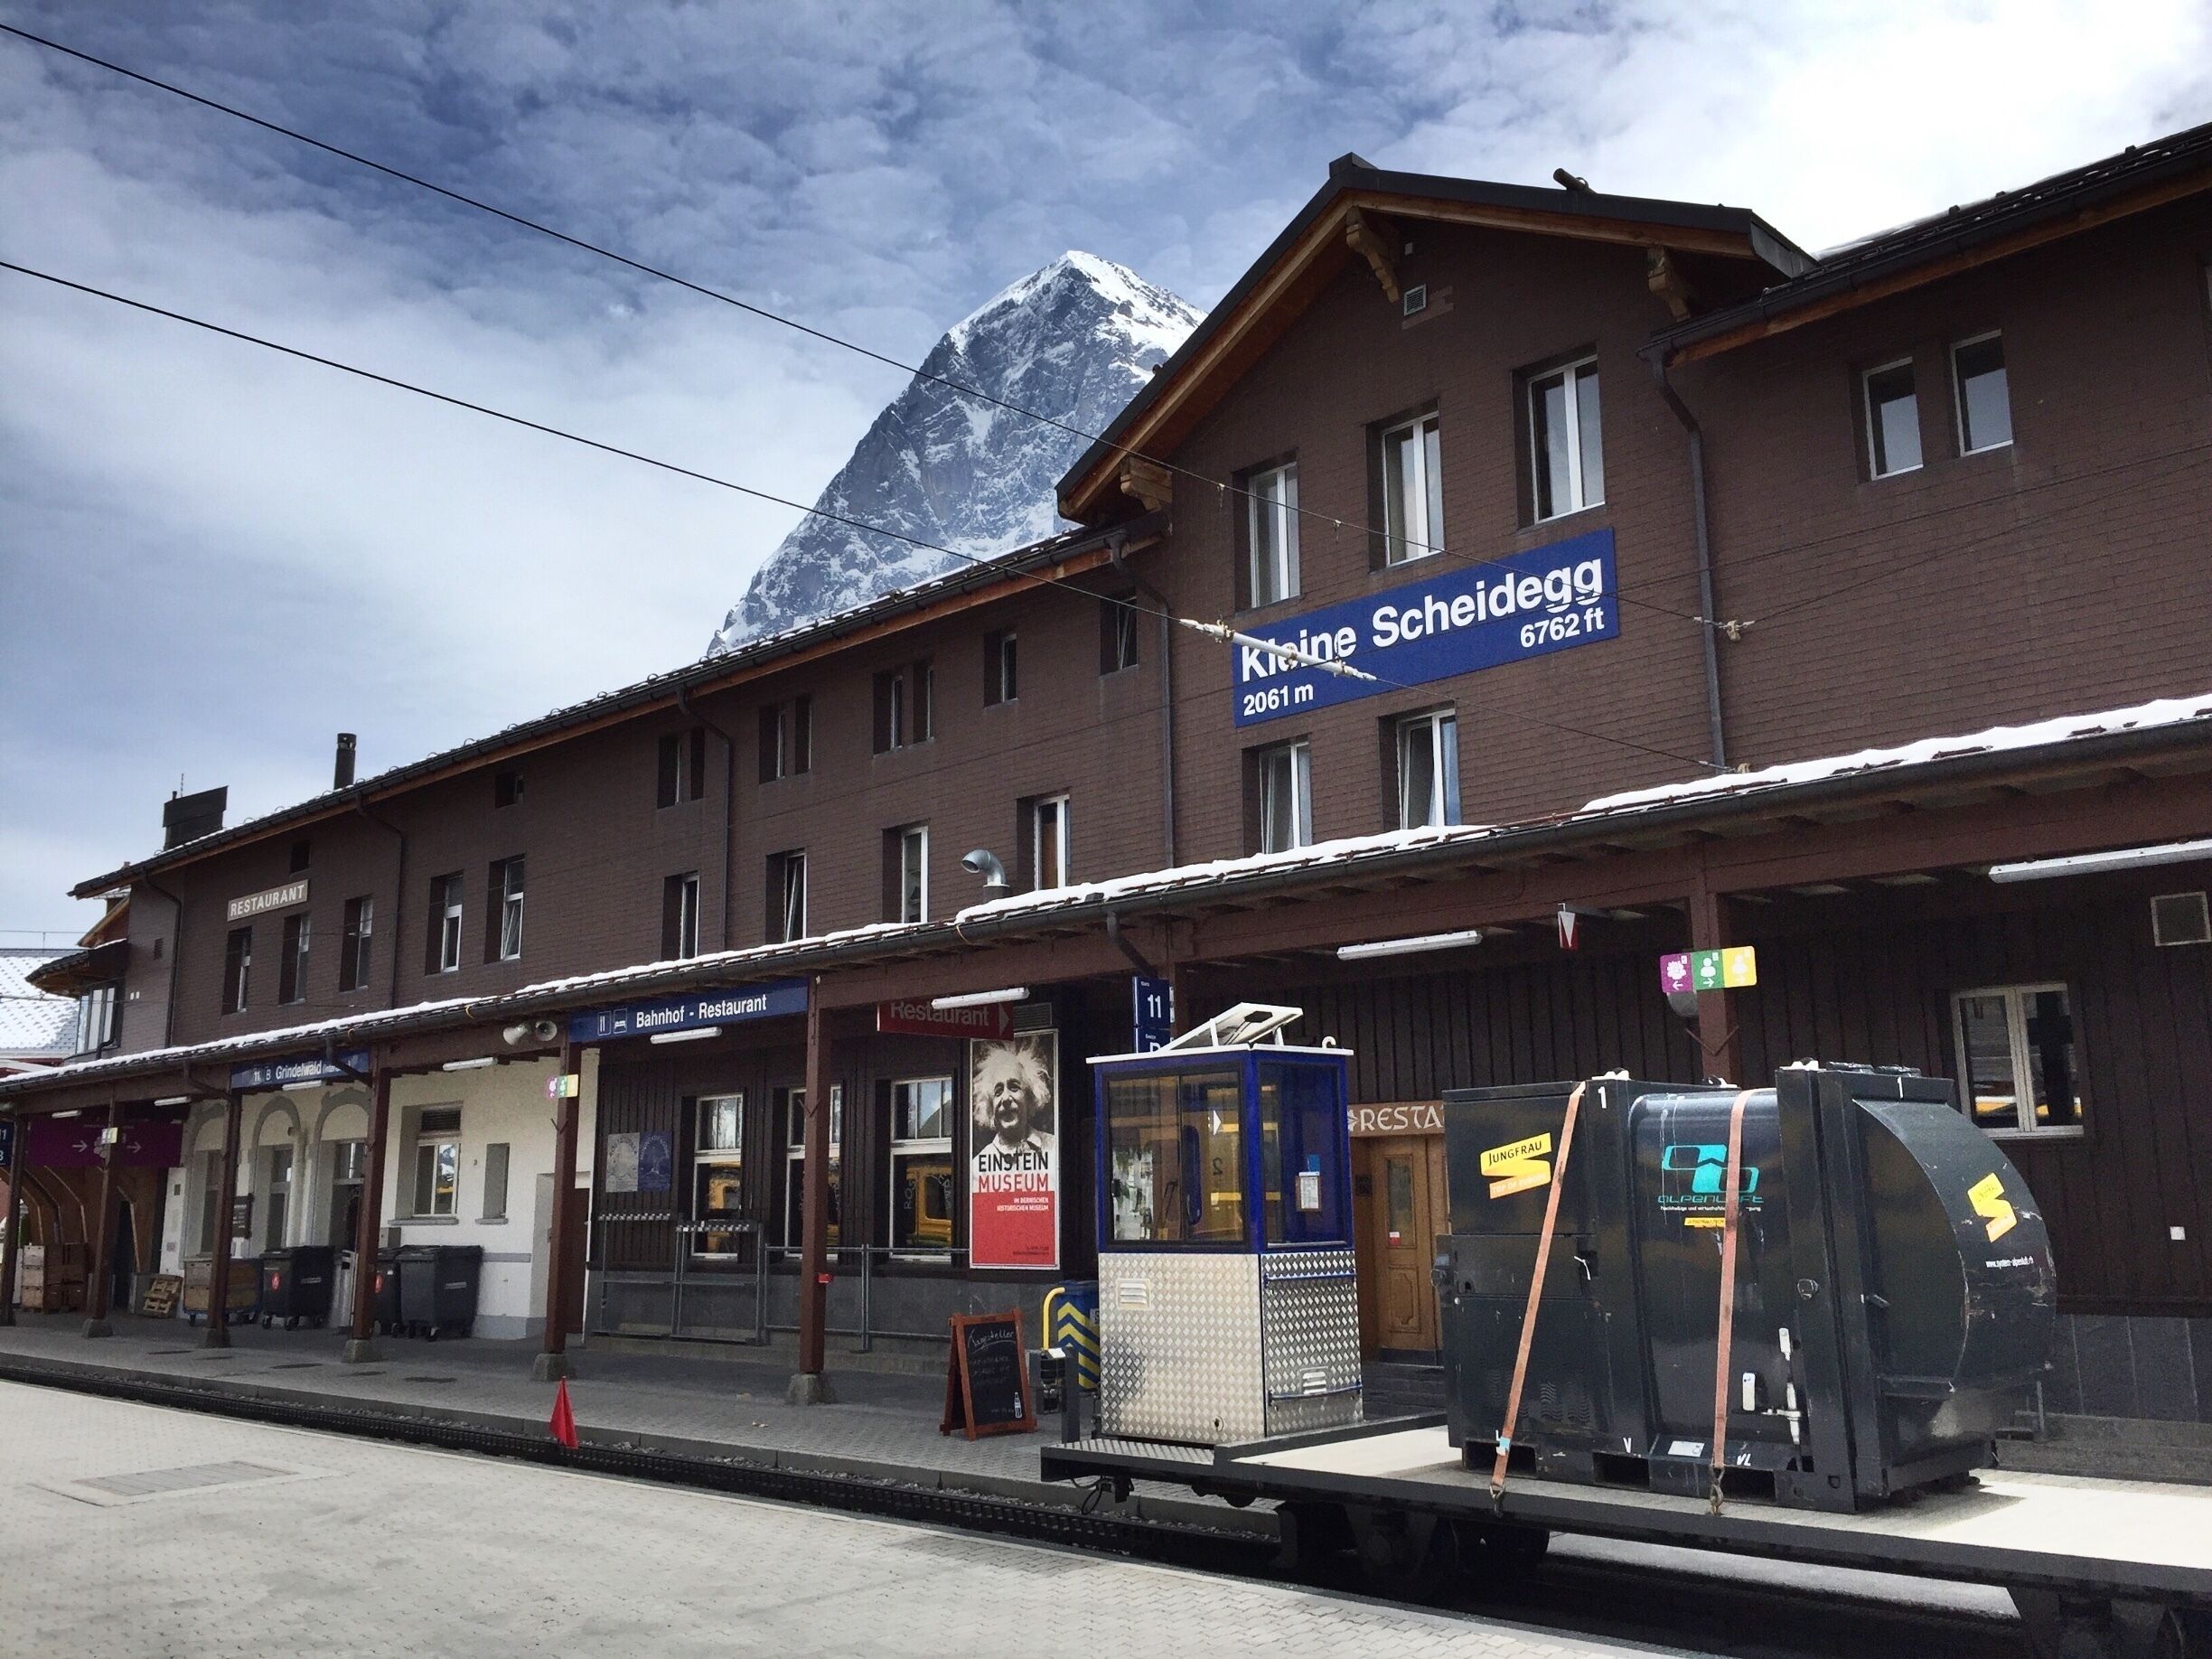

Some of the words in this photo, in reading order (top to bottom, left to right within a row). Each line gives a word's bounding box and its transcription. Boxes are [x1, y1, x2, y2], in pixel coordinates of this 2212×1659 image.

[1372, 558, 1603, 648] Scheidegg
[1520, 617, 1579, 648] 6762
[1584, 606, 1605, 633] ft
[1243, 686, 1289, 717] 2061
[1294, 684, 1314, 704] m
[230, 885, 305, 917] RESTAURANT
[635, 1005, 685, 1028] Bahnhof
[698, 994, 767, 1019] Restaurant
[890, 1000, 989, 1026] Restaurant
[1147, 994, 1162, 1019] 11
[275, 1060, 323, 1080] Grindelwald
[1598, 1086, 1607, 1109] 1
[1897, 1076, 1904, 1099] 1
[1360, 1104, 1445, 1132] RESTA
[979, 1152, 1049, 1172] EINSTEIN
[1488, 1140, 1542, 1167] JUNGFRAU
[979, 1173, 1049, 1193] MUSEUM
[1029, 1204, 1049, 1212] MUSEUM
[1623, 1437, 1632, 1454] V
[1736, 1453, 1752, 1467] VL
